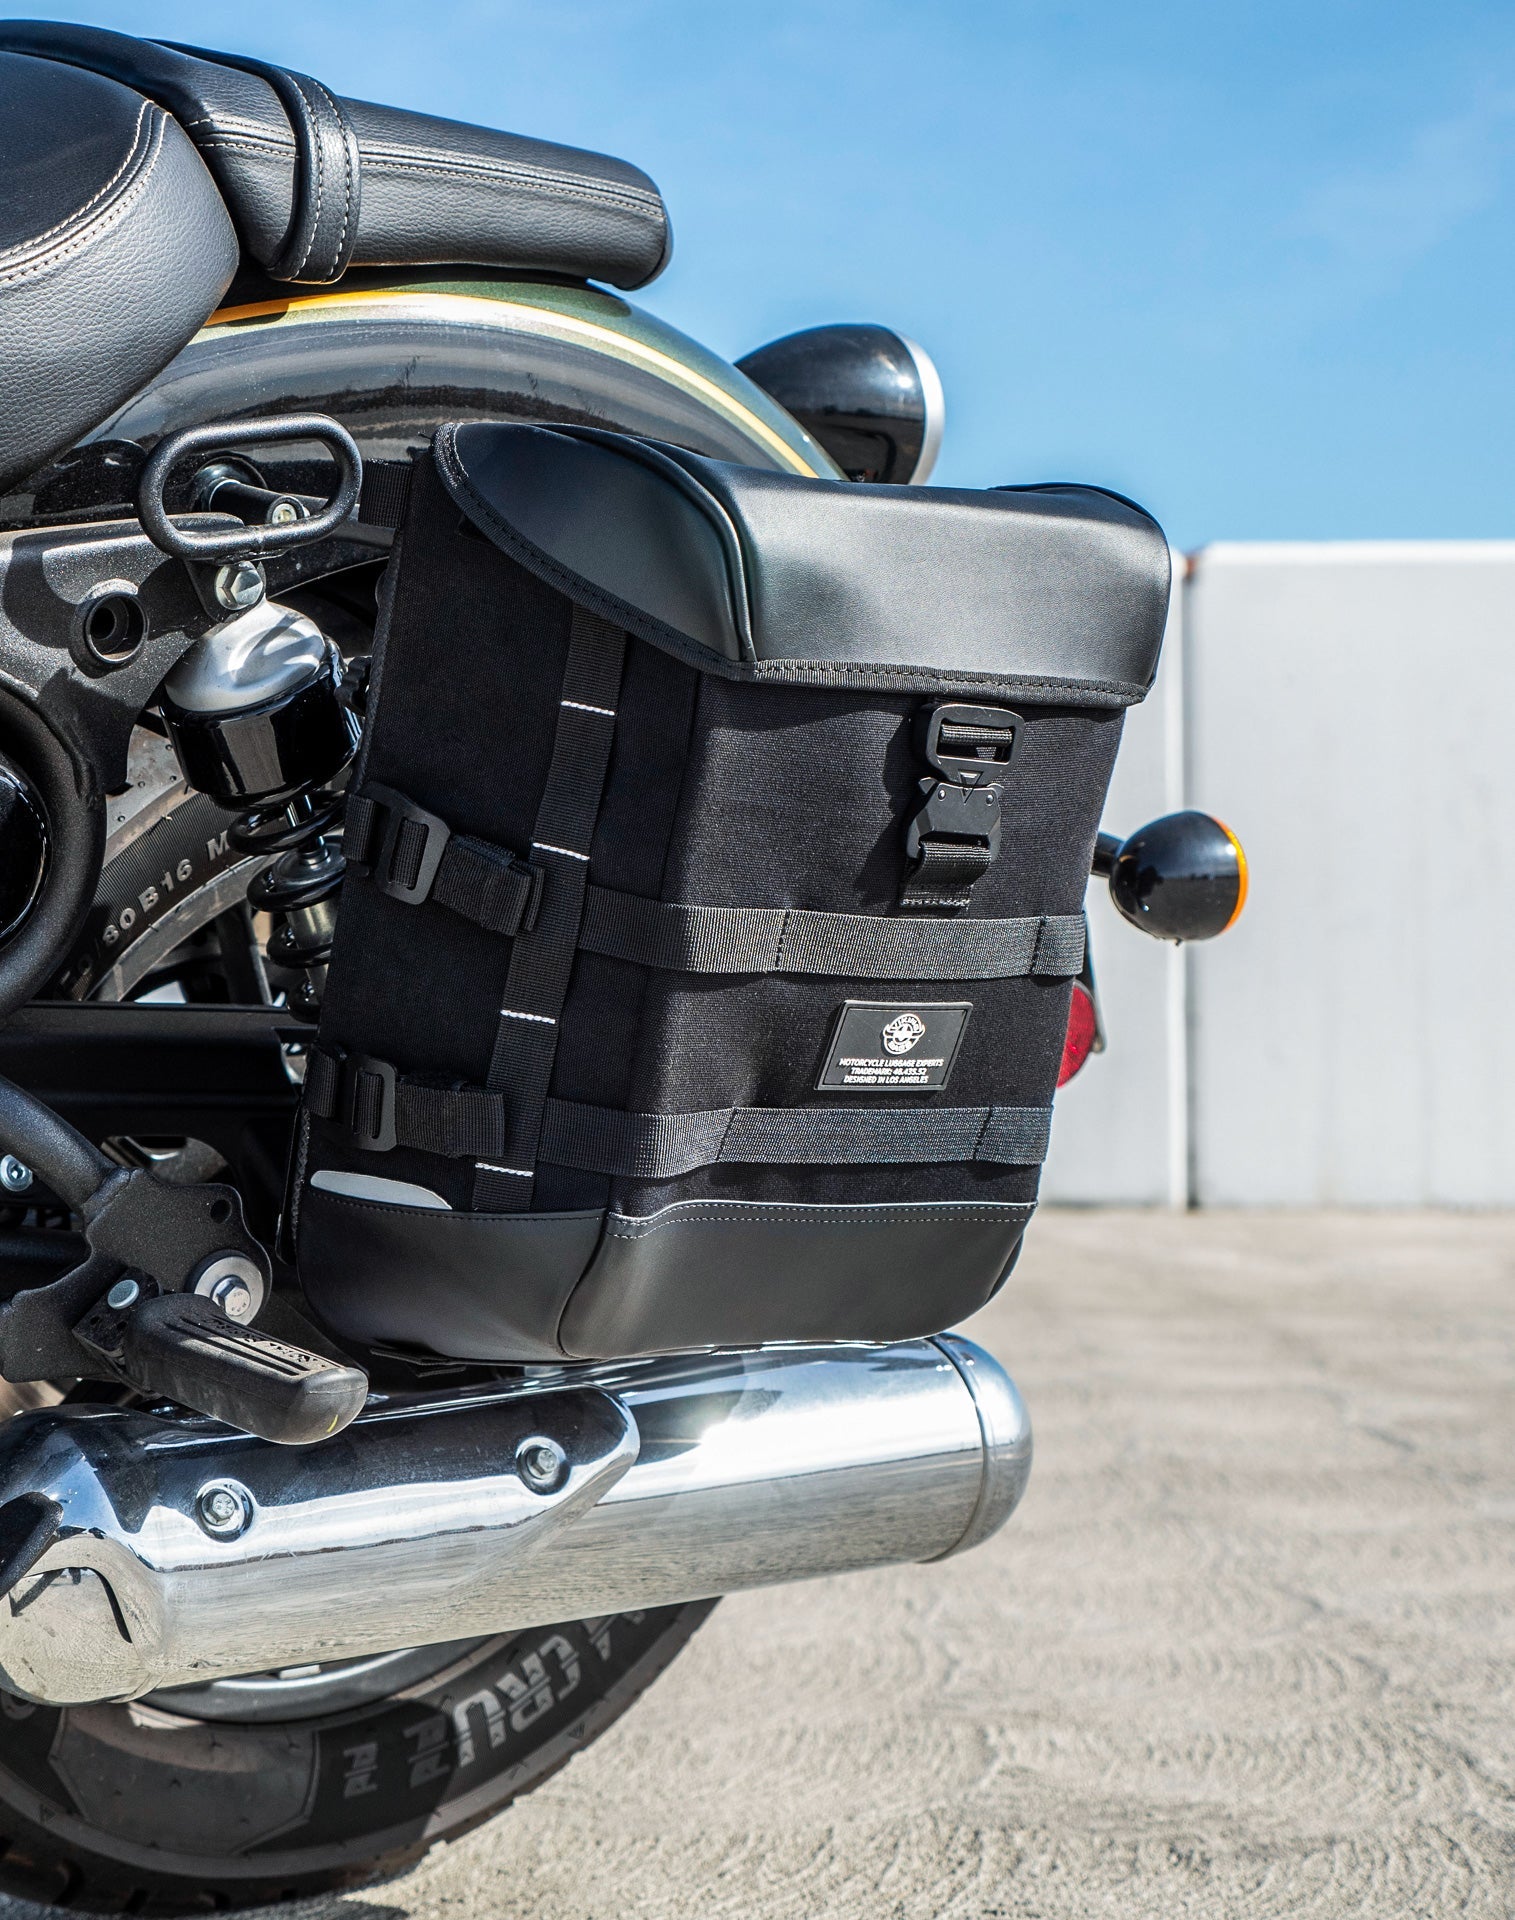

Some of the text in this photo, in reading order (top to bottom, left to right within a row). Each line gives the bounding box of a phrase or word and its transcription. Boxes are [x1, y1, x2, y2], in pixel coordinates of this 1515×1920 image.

[839, 1058, 944, 1067] MOTORCYCLE LUGGAGE EXPERTS
[844, 1075, 877, 1083] DESIGNED
[886, 1076, 900, 1084] LOS
